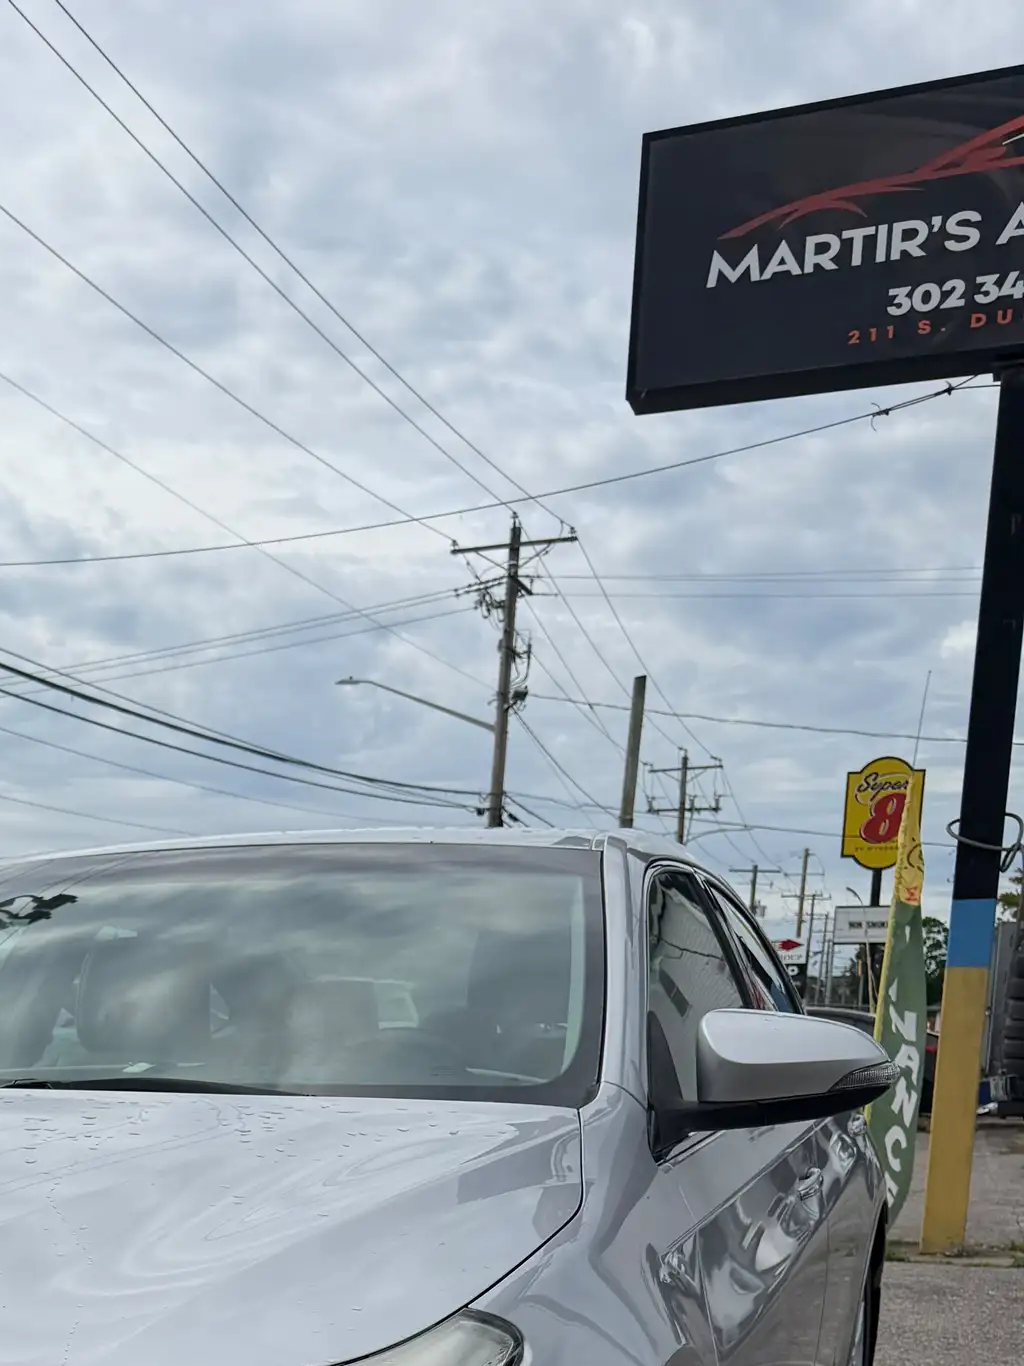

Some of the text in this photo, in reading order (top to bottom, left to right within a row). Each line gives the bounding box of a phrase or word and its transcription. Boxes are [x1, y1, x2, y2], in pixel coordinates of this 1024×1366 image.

[706, 210, 983, 288] MARTIR'S
[887, 279, 966, 316] 302
[847, 325, 895, 345] 211
